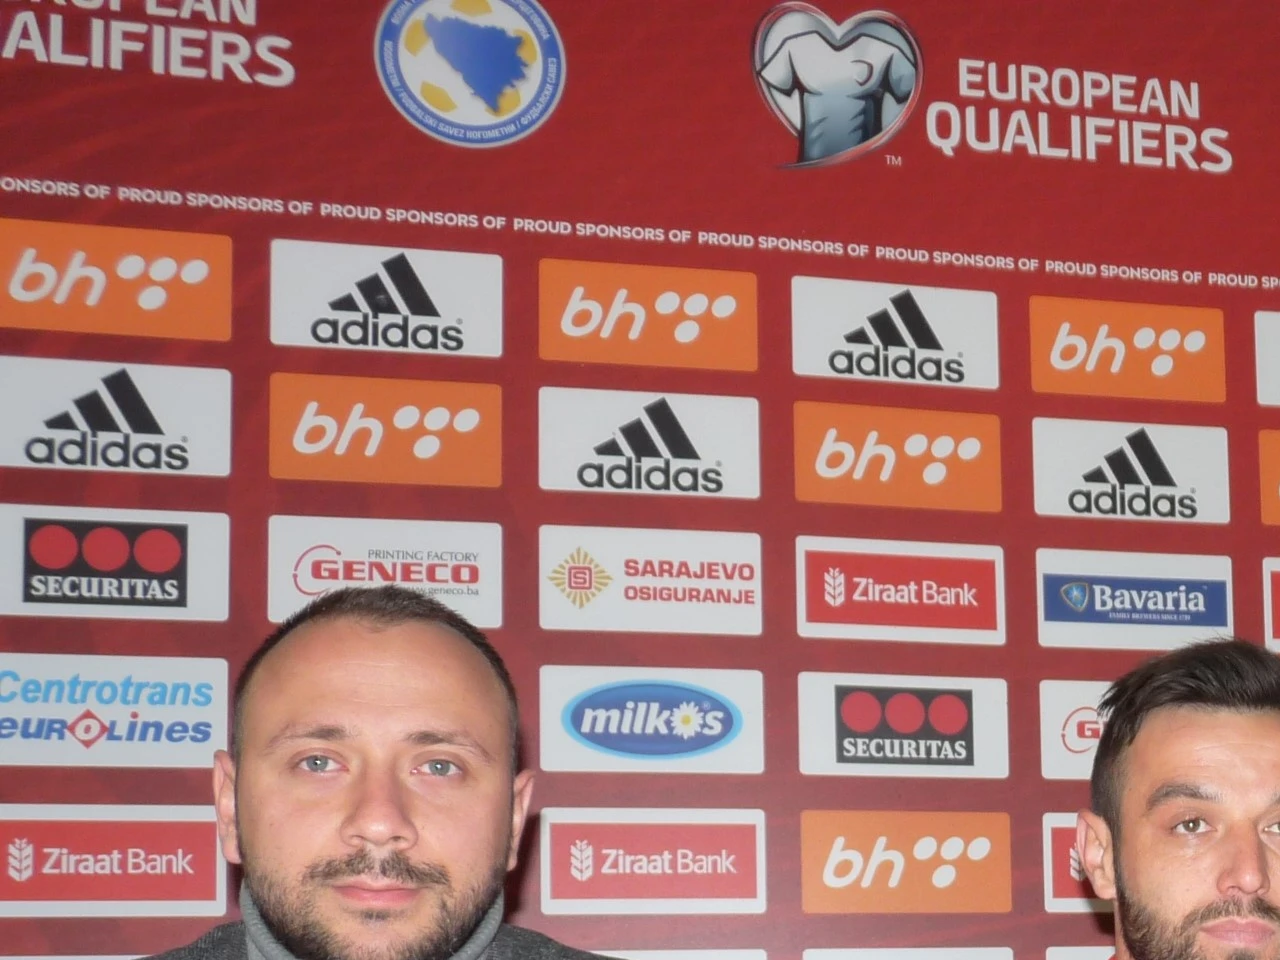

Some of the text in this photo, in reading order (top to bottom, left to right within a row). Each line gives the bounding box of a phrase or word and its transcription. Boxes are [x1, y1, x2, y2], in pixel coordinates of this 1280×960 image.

[2, 6, 295, 87] ALIFIERS
[958, 58, 1200, 119] EUROPEAN
[926, 101, 1233, 173] QUALIFIERS
[0, 177, 80, 197] ONSORS
[83, 184, 110, 199] OF
[118, 187, 183, 205] PROUD
[186, 193, 284, 213] SPONSORS
[288, 201, 313, 214] OF
[320, 203, 381, 220] PROUD
[386, 208, 478, 227] SPONSORS
[483, 216, 506, 229] OF
[514, 218, 571, 234] PROUD
[576, 223, 664, 241] SPONSORS
[669, 230, 691, 242] OF
[698, 232, 754, 247] PROUD
[758, 236, 843, 255] SPONSORS
[848, 244, 868, 256] OF
[876, 246, 929, 262] PROUD
[933, 251, 1014, 269] SPONSORS
[1018, 258, 1038, 271] OF
[1046, 260, 1097, 275] PROUD
[1101, 265, 1179, 282] SPONSORS
[1182, 271, 1202, 283] OF
[1209, 273, 1258, 287] PROUD
[311, 311, 464, 351] adidas
[828, 345, 964, 383] adidas
[25, 431, 189, 470] adidas
[577, 457, 723, 493] adidas
[1069, 483, 1198, 519] adidas
[311, 559, 480, 583] GENECO
[368, 549, 480, 562] PRINTING FACTORY
[624, 559, 754, 581] SARAJEVO
[30, 575, 179, 600] SECURITAS
[624, 586, 754, 604] OSIGURANJE
[853, 578, 977, 606] Ziraat Bank
[1093, 585, 1205, 611] Bavaria
[0, 670, 213, 706] Centrotrans
[843, 738, 966, 759] SECURITAS
[42, 848, 193, 874] Ziraat Bank
[601, 849, 736, 874] Ziraat Bank
